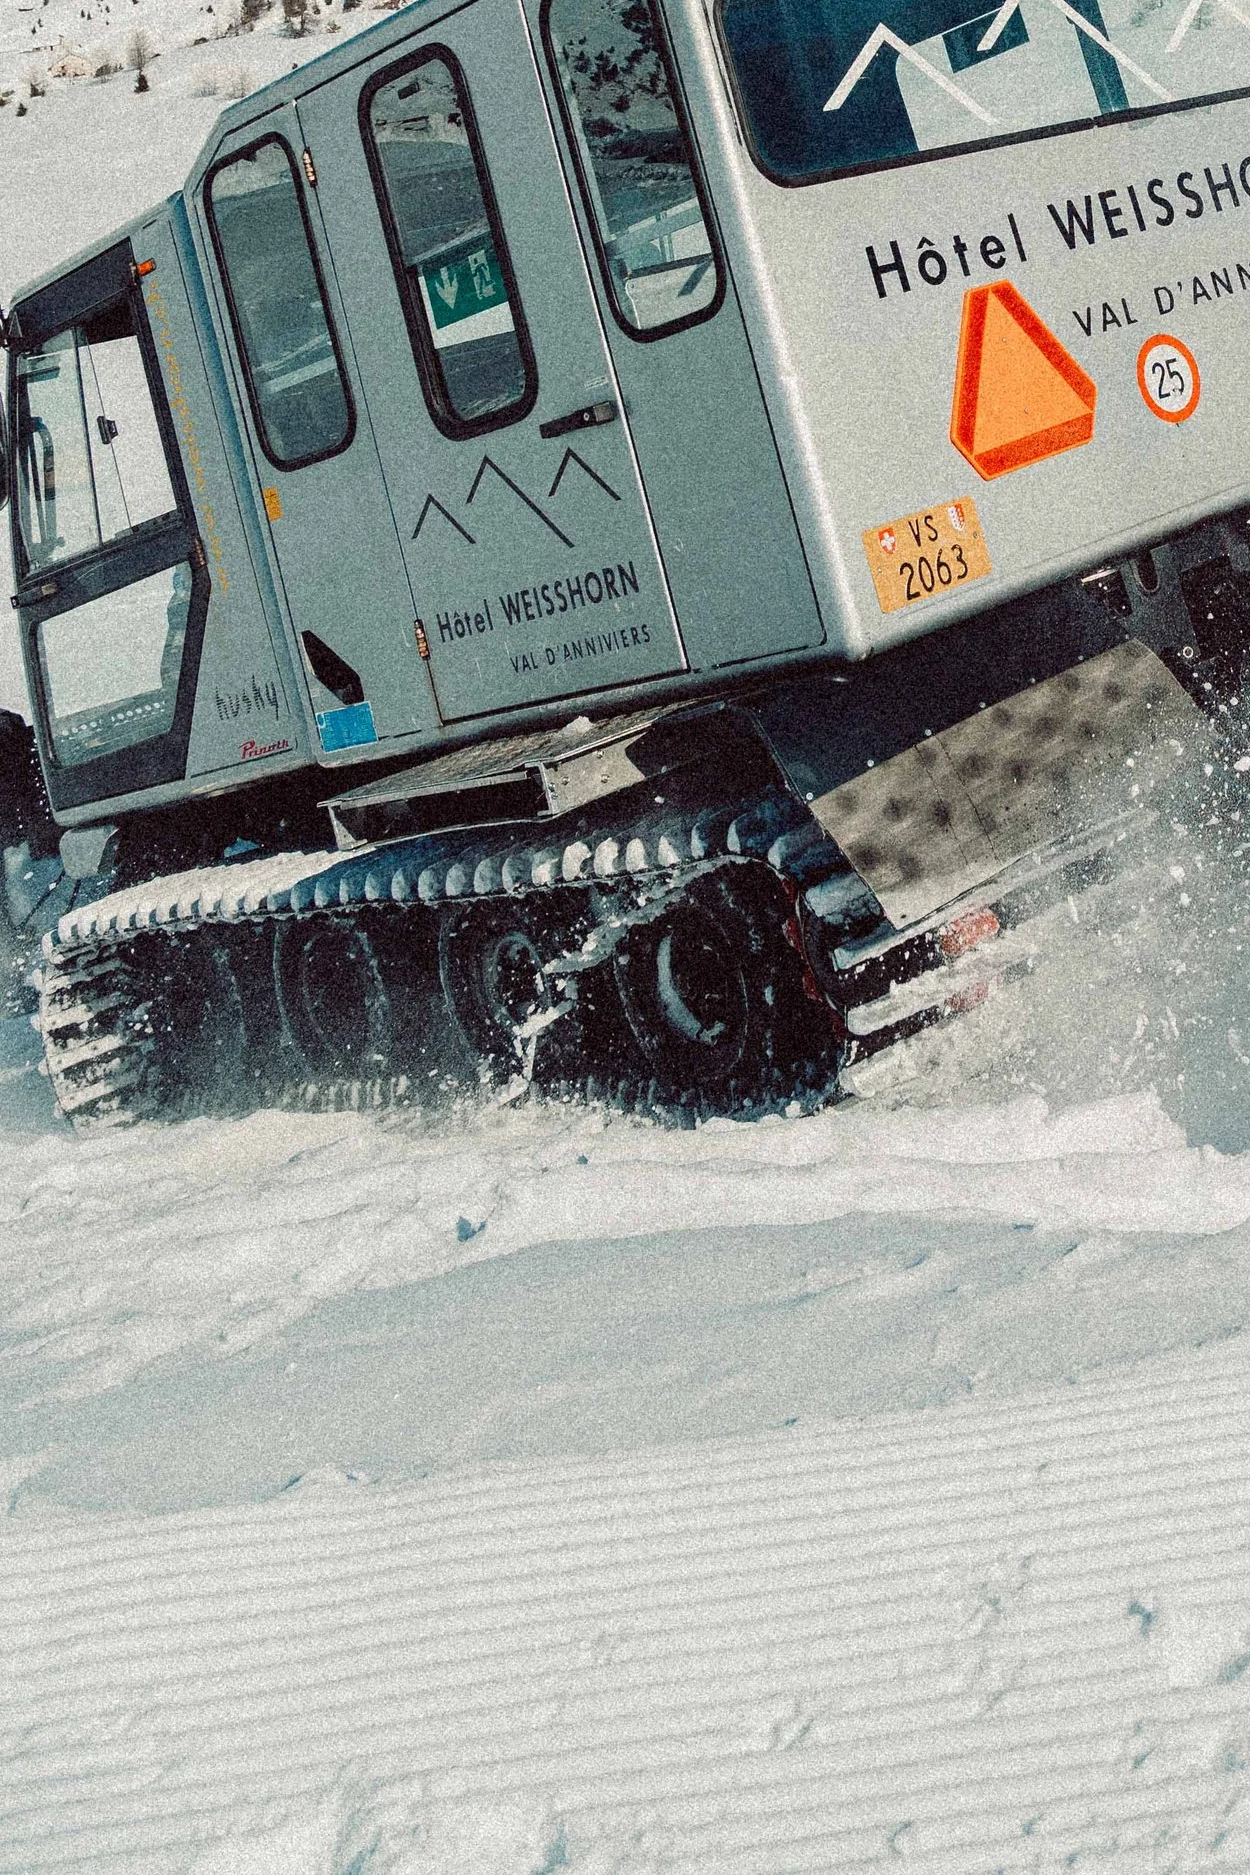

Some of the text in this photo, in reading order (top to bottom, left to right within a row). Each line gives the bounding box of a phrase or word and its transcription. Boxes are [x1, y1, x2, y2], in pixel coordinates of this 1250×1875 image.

[865, 212, 1028, 299] Hôtel
[1072, 297, 1138, 337] VAL
[1151, 358, 1185, 399] 25
[908, 514, 938, 547] VS
[899, 543, 968, 601] 2063
[435, 560, 640, 643] Hôtel WEISSHORN
[509, 623, 651, 674] VAL D'ANNIVIERS
[215, 674, 279, 721] husky
[238, 738, 290, 760] Prinoth
